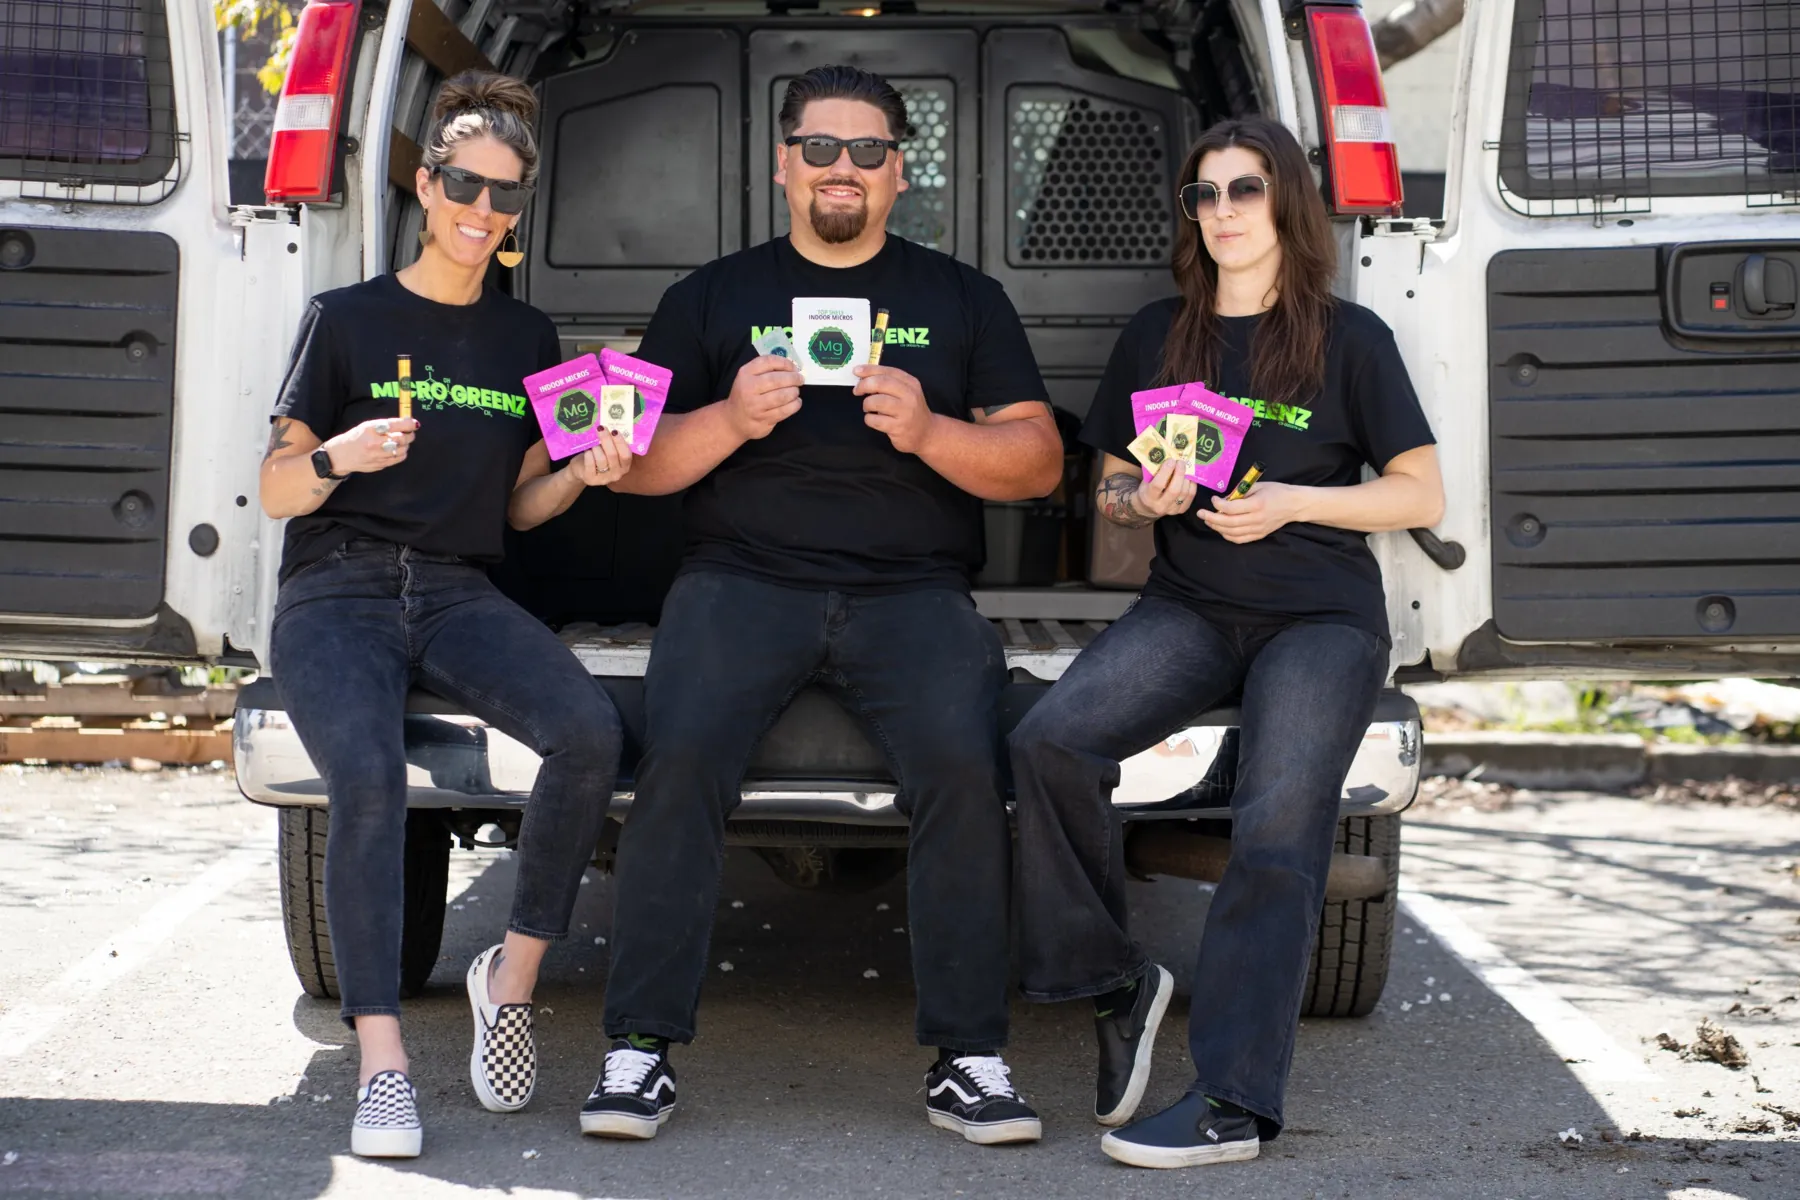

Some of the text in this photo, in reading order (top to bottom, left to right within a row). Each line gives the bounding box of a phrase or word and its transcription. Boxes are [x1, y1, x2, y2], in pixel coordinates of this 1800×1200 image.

[819, 340, 843, 356] Mg
[538, 369, 590, 393] INDOOR MICROS
[608, 363, 659, 387] INDOOR MICROS
[450, 384, 527, 416] GREENZ
[563, 401, 589, 419] Mg
[1145, 400, 1170, 412] INDOOR
[1190, 399, 1216, 415] INDOOR
[1215, 409, 1240, 425] MICROS
